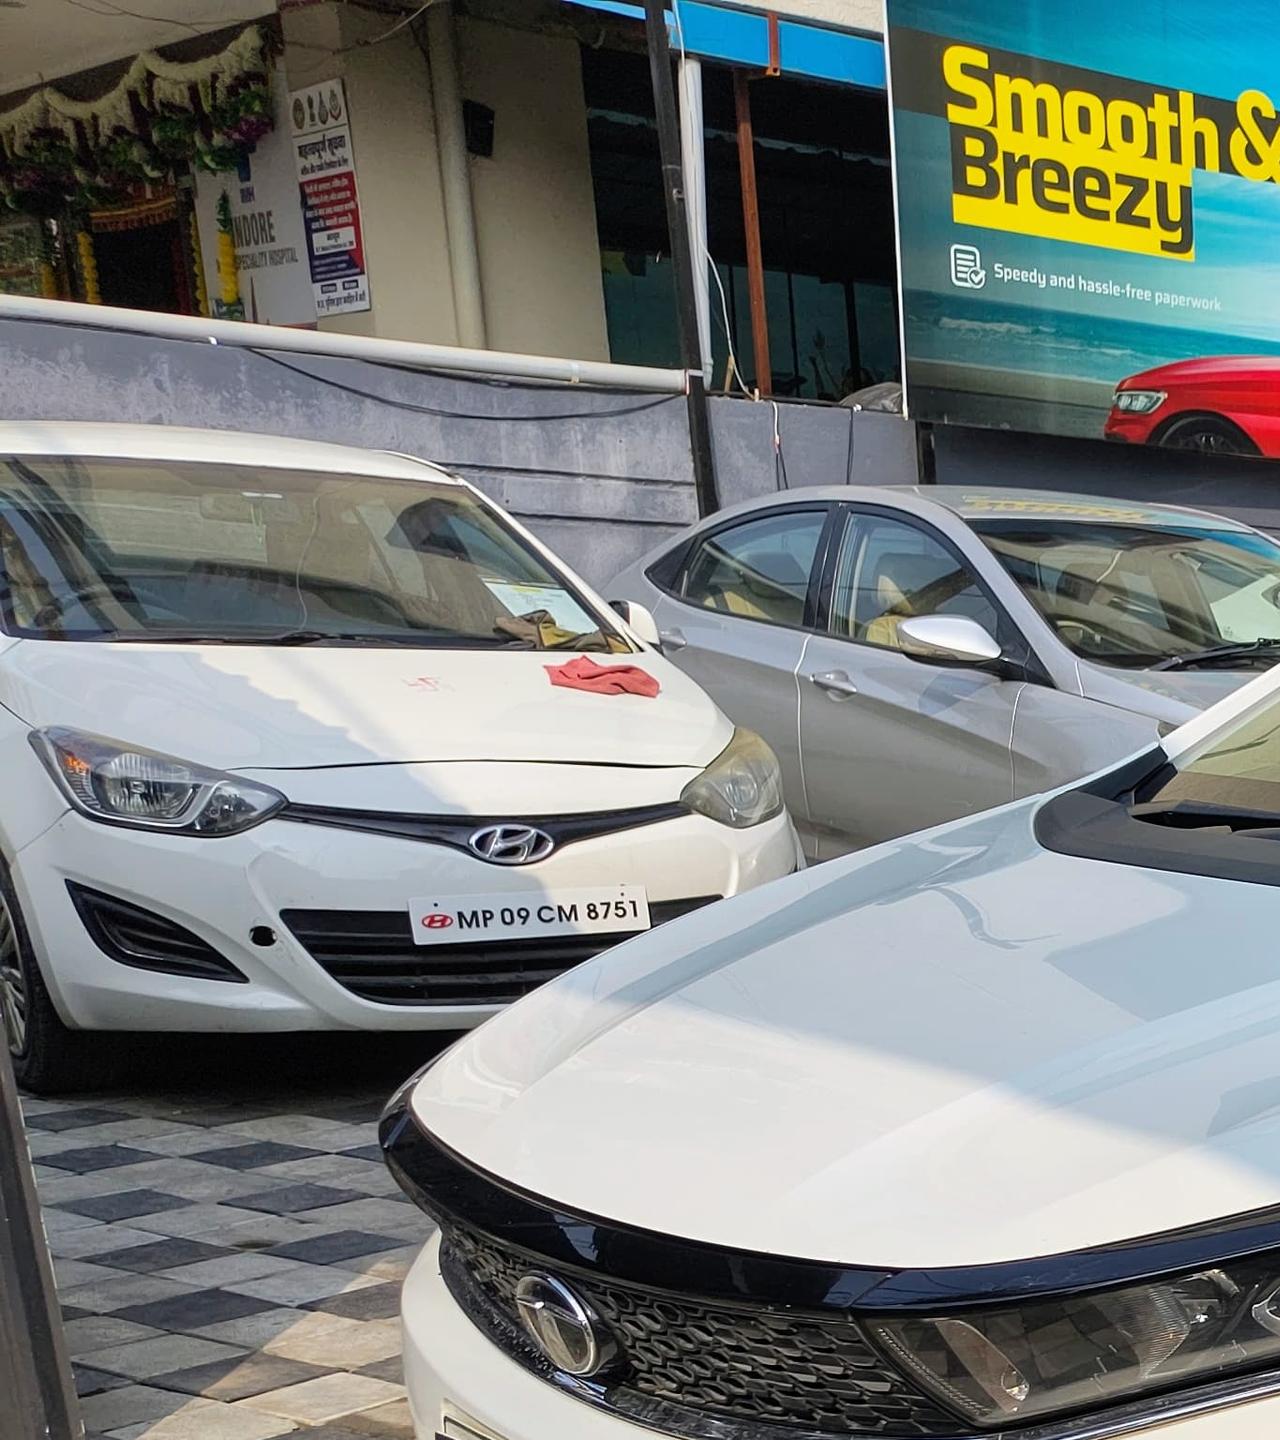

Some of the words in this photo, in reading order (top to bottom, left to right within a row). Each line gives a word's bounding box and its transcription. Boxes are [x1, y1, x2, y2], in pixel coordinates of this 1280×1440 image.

[943, 45, 1219, 173] Smooth
[952, 126, 1194, 253] Breezy
[994, 263, 1047, 289] Speedy
[1050, 272, 1075, 290] and
[1078, 275, 1152, 302] hassle-free
[1155, 291, 1221, 313] paperwork
[457, 910, 495, 930] MP
[500, 907, 530, 926] 09
[537, 904, 579, 924] CM
[586, 900, 639, 920] 8751
